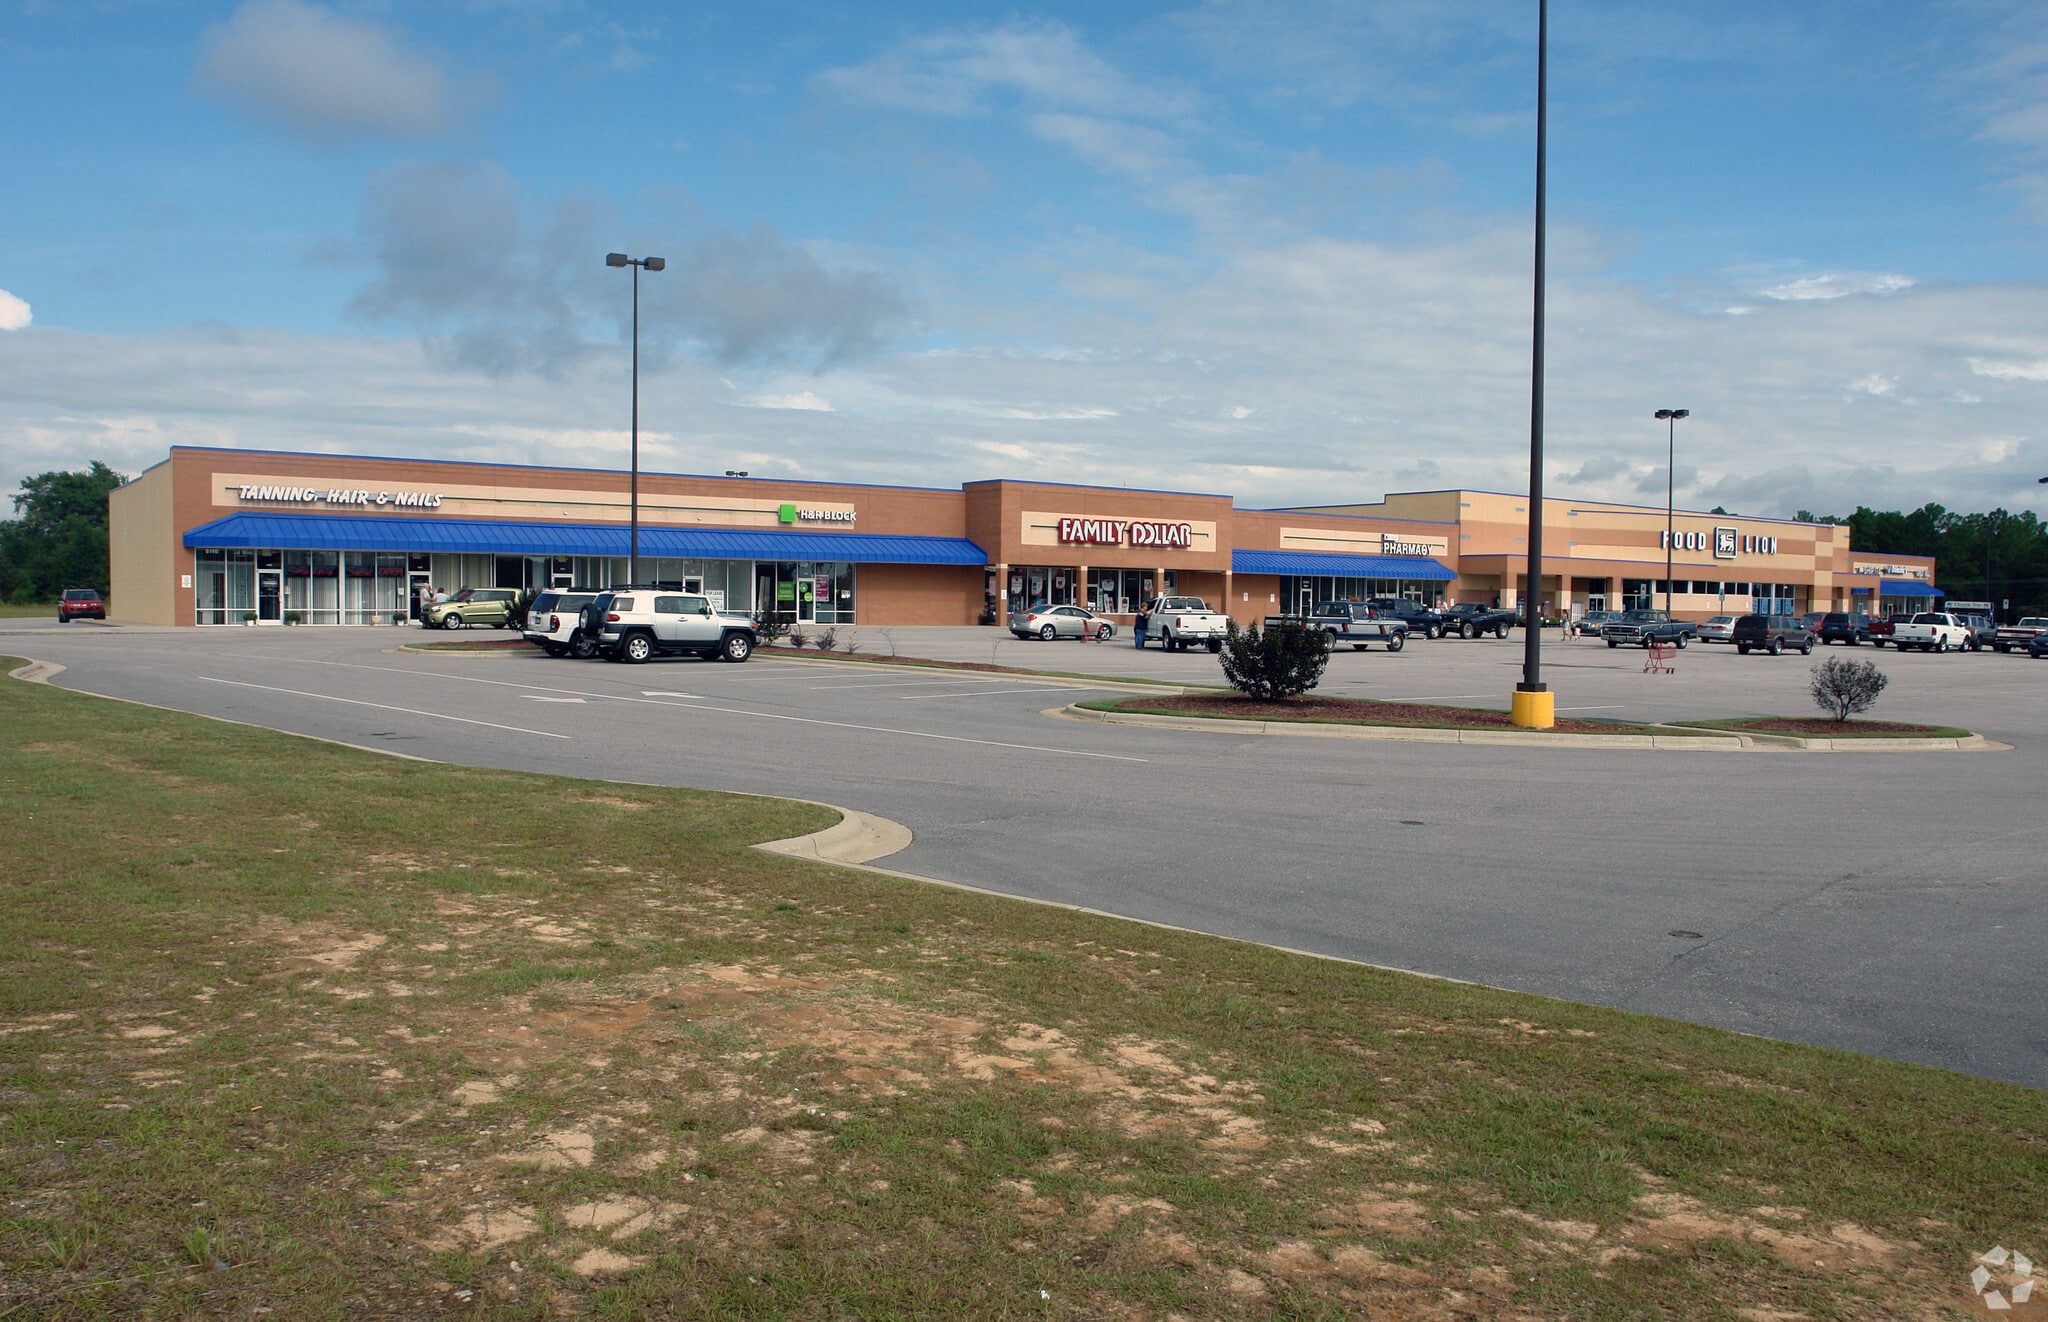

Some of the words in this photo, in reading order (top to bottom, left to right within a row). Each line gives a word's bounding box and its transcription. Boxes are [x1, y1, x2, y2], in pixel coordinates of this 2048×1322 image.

[238, 484, 319, 502] TANNING,
[326, 488, 370, 505] HAIR
[376, 491, 388, 505] &
[394, 492, 444, 507] NAILS
[800, 509, 822, 520] H&R
[824, 510, 857, 521] BLOCK
[1060, 518, 1126, 544] FAMILY
[1130, 522, 1191, 547] DOLLAR
[1661, 530, 1706, 550] FOOD
[1744, 535, 1777, 554] LION
